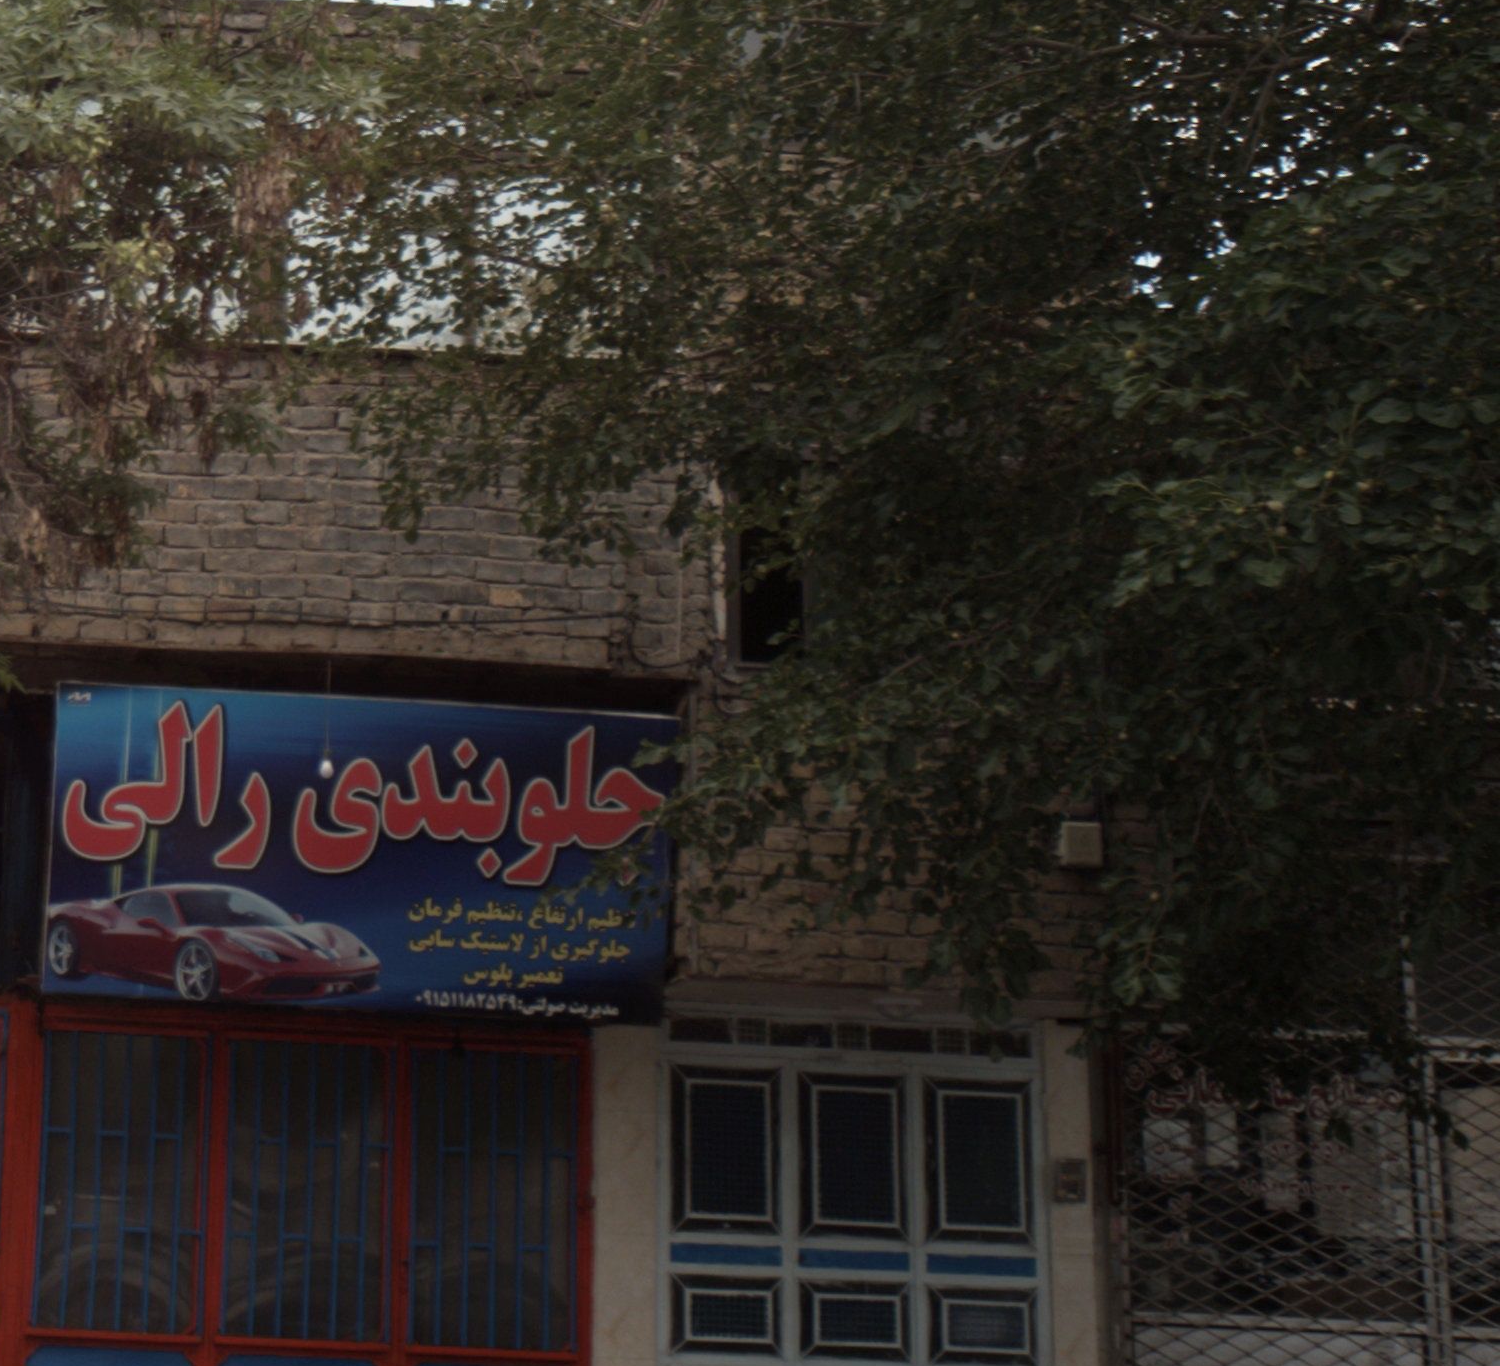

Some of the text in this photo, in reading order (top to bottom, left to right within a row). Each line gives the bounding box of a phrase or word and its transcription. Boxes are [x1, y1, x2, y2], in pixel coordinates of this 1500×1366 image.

[62, 699, 270, 869] رالی
[407, 897, 463, 924] فرمان
[460, 929, 525, 954] لاستیک
[528, 935, 548, 959] از
[518, 966, 565, 988] تعمیر
